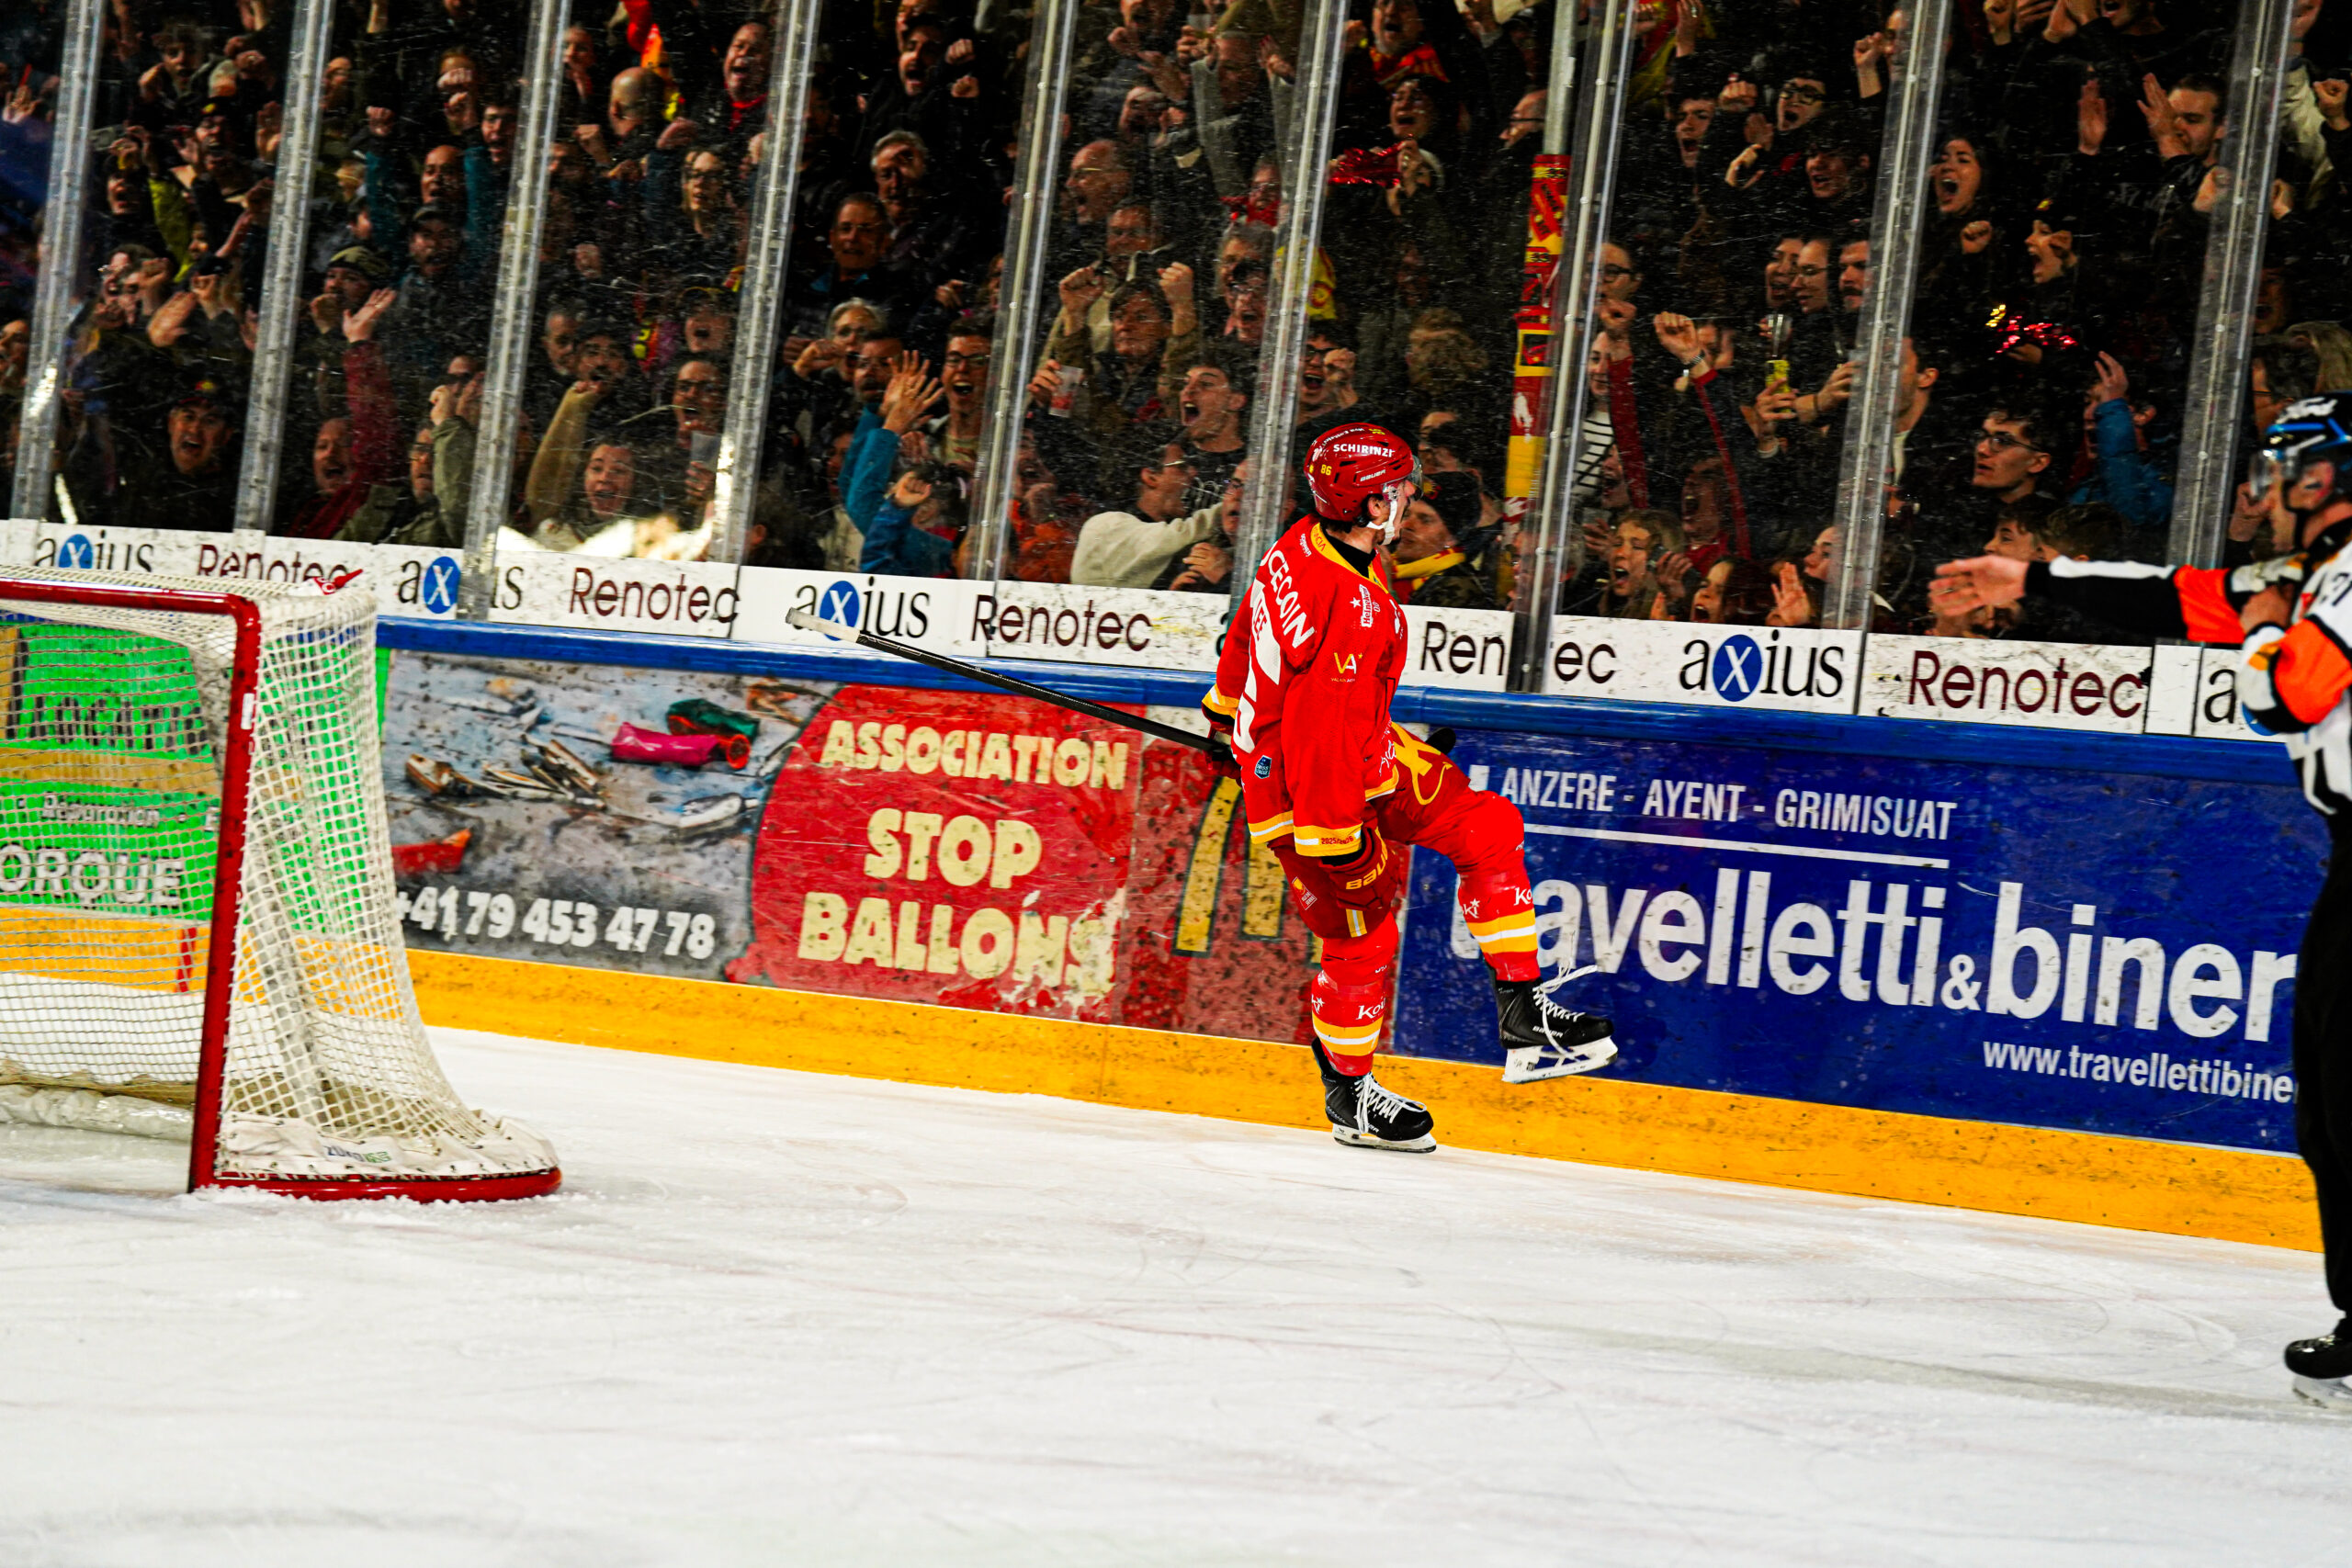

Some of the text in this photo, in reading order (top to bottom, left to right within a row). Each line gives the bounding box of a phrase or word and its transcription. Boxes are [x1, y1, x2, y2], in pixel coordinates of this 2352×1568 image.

[1320, 464, 1332, 476] 86
[570, 567, 741, 624] Renotec
[792, 576, 930, 640] axius
[972, 594, 1150, 651] Renotec
[1420, 620, 1617, 683] Renec
[1679, 629, 1845, 702] axius
[1907, 649, 2143, 718] Renotec
[820, 719, 1129, 791] ASSOCIATION
[1499, 766, 1617, 813] ANZERE
[1641, 778, 1747, 823] AYENT
[1774, 788, 1958, 840] GRIMISUAT
[864, 807, 1042, 889] STOP
[397, 886, 716, 960] +41 79 453 47 78
[797, 891, 1114, 998] BALLONS
